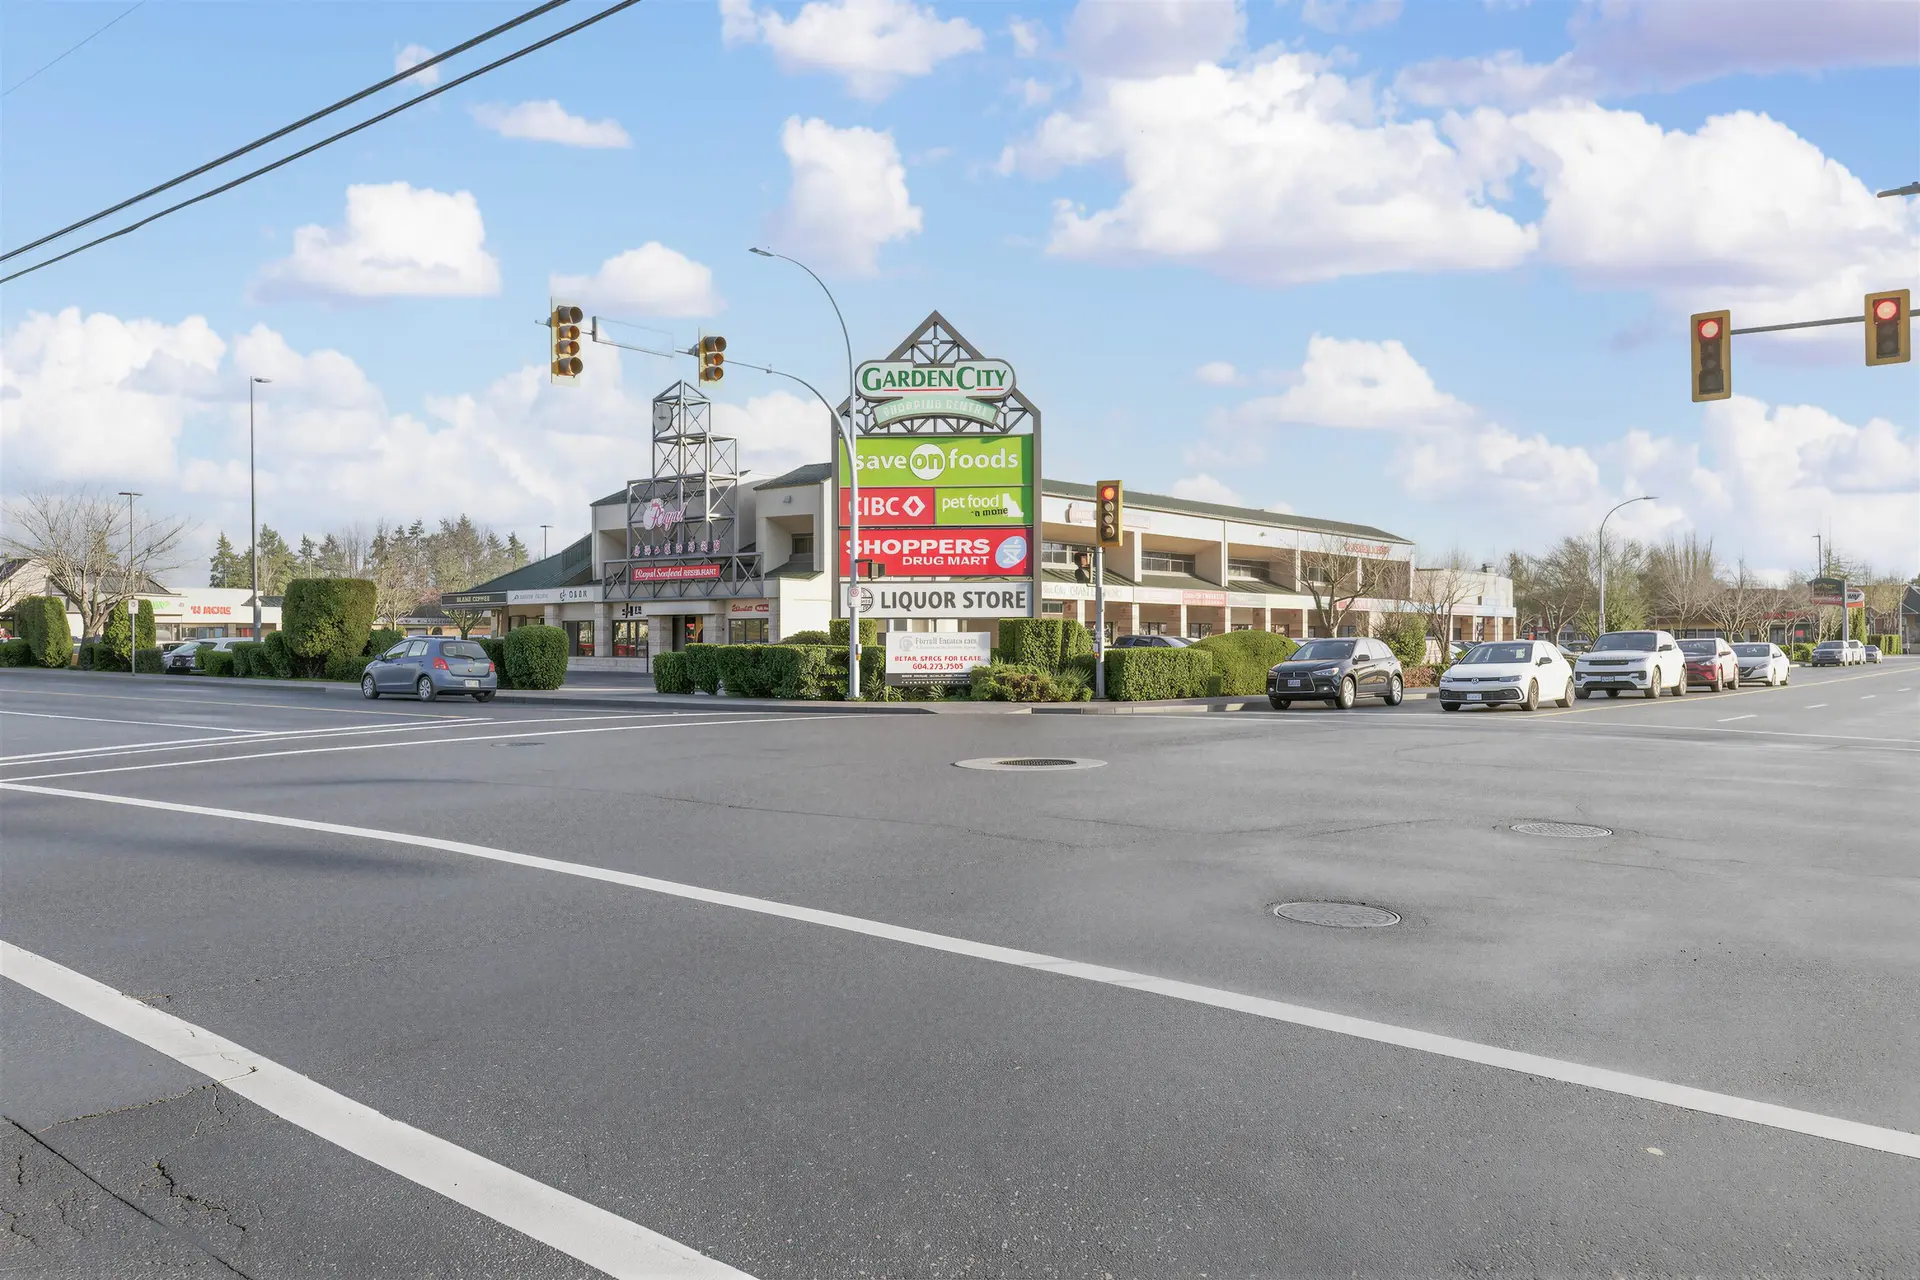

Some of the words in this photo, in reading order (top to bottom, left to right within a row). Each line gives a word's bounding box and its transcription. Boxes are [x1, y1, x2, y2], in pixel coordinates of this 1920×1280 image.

[854, 454, 907, 470] save
[911, 453, 943, 470] on
[949, 447, 1018, 469] foods
[942, 497, 965, 512] pet
[967, 494, 999, 508] food
[845, 538, 990, 555] SHOPPERS
[902, 556, 944, 566] DRUG
[947, 556, 990, 566] MART
[881, 591, 957, 611] LIQUOR
[963, 590, 1026, 609] STORE
